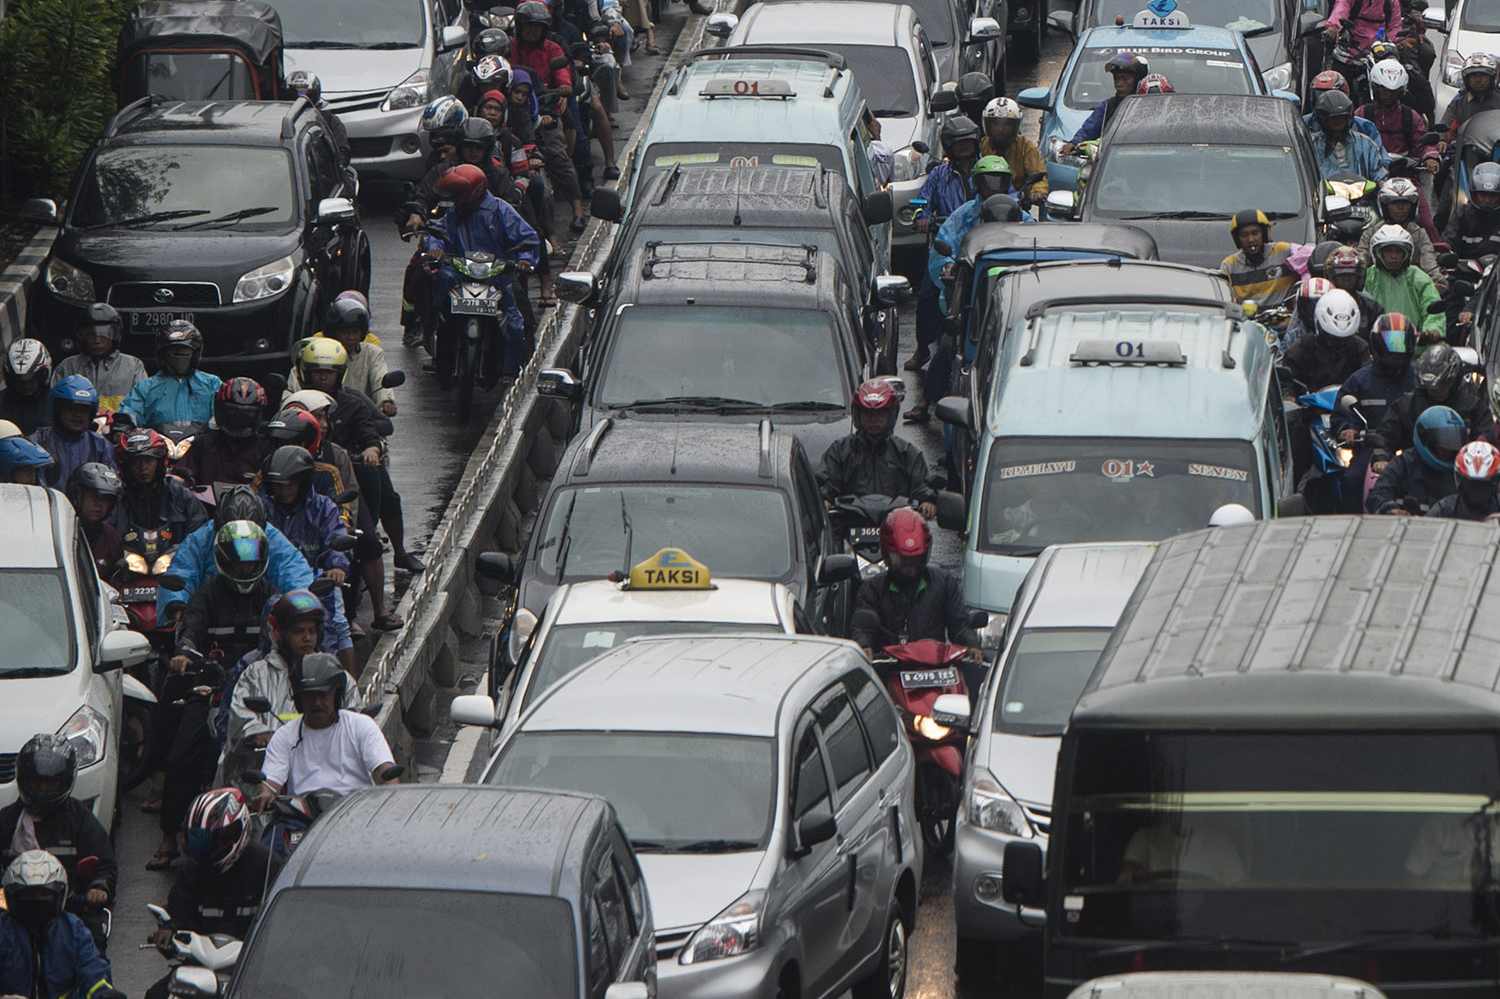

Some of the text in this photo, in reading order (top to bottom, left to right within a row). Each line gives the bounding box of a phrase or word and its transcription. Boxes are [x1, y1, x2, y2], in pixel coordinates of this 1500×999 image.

[1142, 17, 1181, 26] TAKSI
[1150, 46, 1183, 54] BIRD
[1185, 47, 1230, 58] GROUP
[734, 80, 760, 95] 01
[132, 313, 139, 326] B
[145, 313, 173, 326] 2980
[1115, 341, 1145, 358] 01
[1102, 459, 1134, 477] 01
[1188, 463, 1248, 481] SENEN
[644, 570, 700, 584] TAKSI
